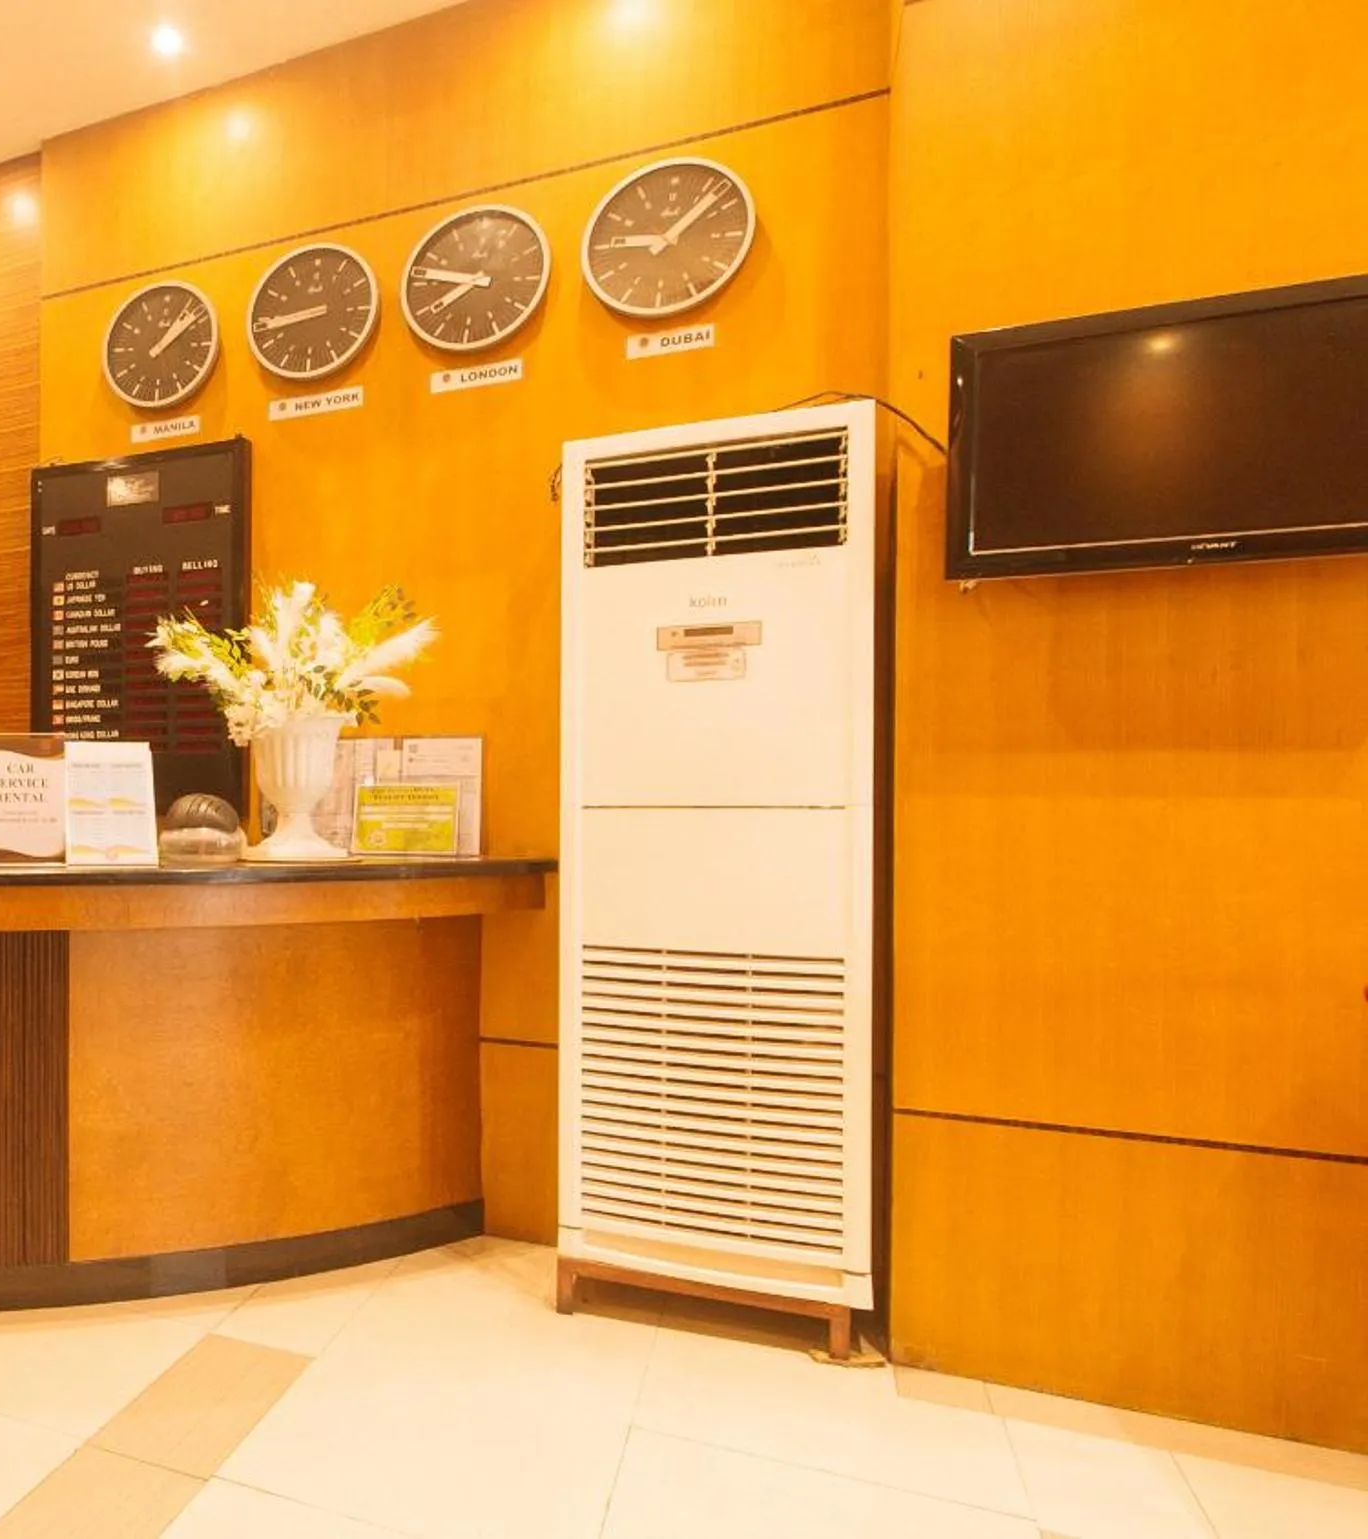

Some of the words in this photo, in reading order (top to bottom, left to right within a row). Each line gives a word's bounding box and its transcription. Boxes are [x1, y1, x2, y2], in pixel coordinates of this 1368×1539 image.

[660, 328, 711, 348] DUBAI
[460, 365, 519, 384] LONDON
[295, 399, 323, 412] NEW
[326, 392, 360, 406] YORK
[153, 419, 196, 435] MANILA
[6, 763, 35, 774] CAR
